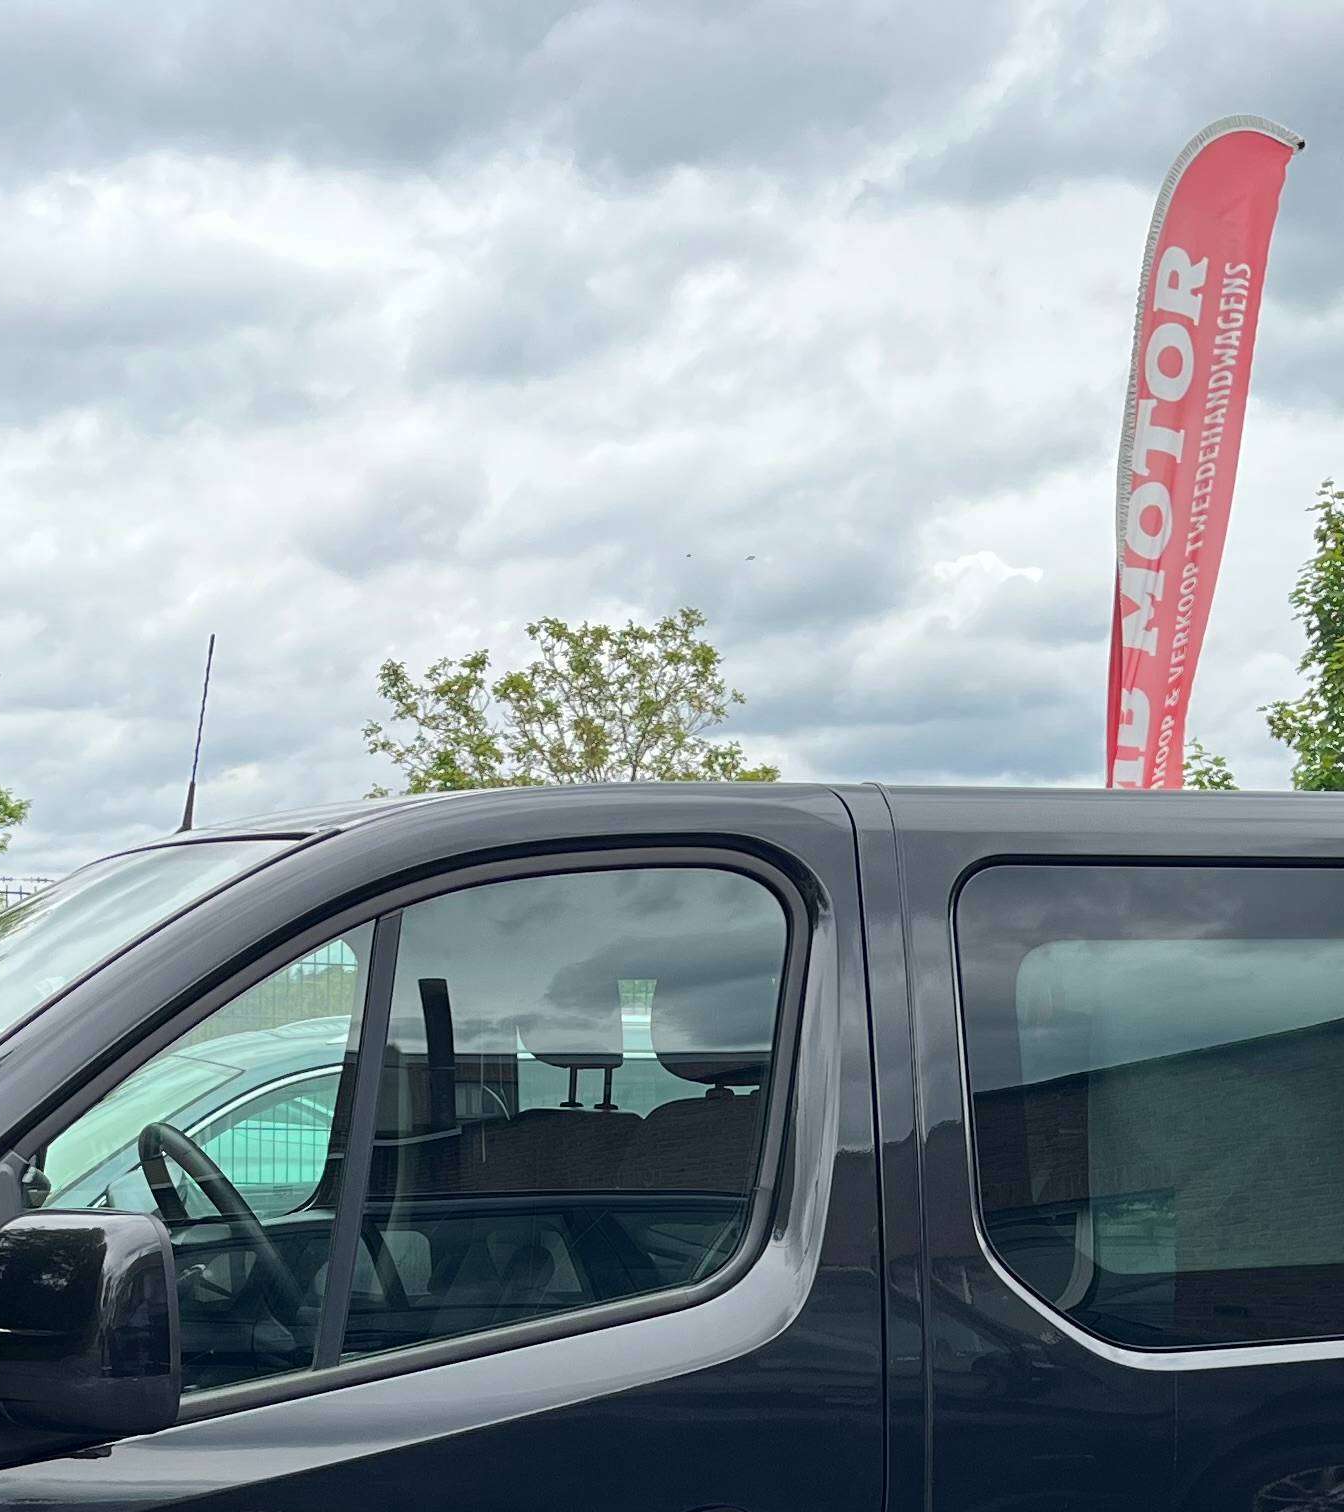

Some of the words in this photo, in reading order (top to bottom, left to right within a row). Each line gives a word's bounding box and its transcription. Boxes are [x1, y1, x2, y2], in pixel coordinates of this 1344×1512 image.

[1119, 246, 1208, 657] MOTOR
[1183, 262, 1252, 556] TWEEDEHANDWAGENS
[1168, 562, 1199, 684] VERKOOP
[1150, 715, 1174, 789] KOOP
[1164, 687, 1180, 707] &
